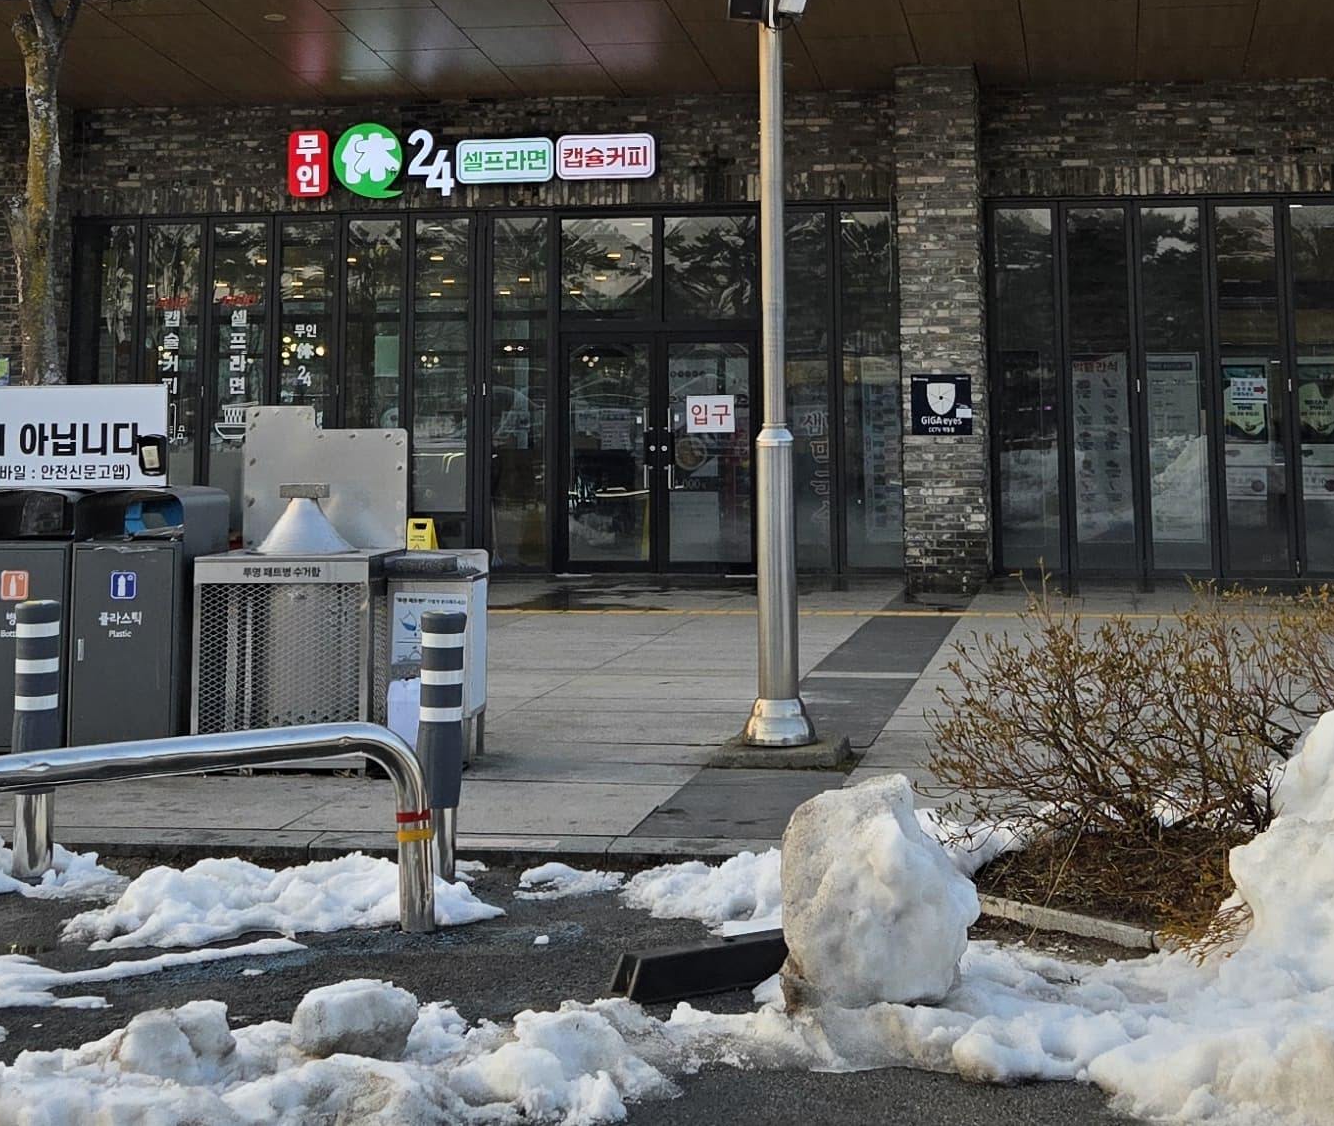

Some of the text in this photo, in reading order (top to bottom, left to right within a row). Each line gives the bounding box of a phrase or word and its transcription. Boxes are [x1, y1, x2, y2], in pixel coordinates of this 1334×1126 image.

[295, 133, 321, 192] 무인
[407, 129, 455, 196] 24
[462, 148, 547, 174] 셀프라면
[562, 145, 648, 170] 캡슐커피
[294, 324, 317, 338] 무인
[229, 309, 248, 395] 셀프라면
[297, 365, 312, 387] 24
[691, 403, 732, 426] 입구
[19, 422, 139, 457] 아닙니다
[41, 464, 131, 481] 안전신문고앱)
[242, 566, 322, 578] 투명 페트병 수거함
[6, 612, 17, 625] 병
[98, 611, 142, 626] 플라스틱
[108, 629, 133, 639] Plastic
